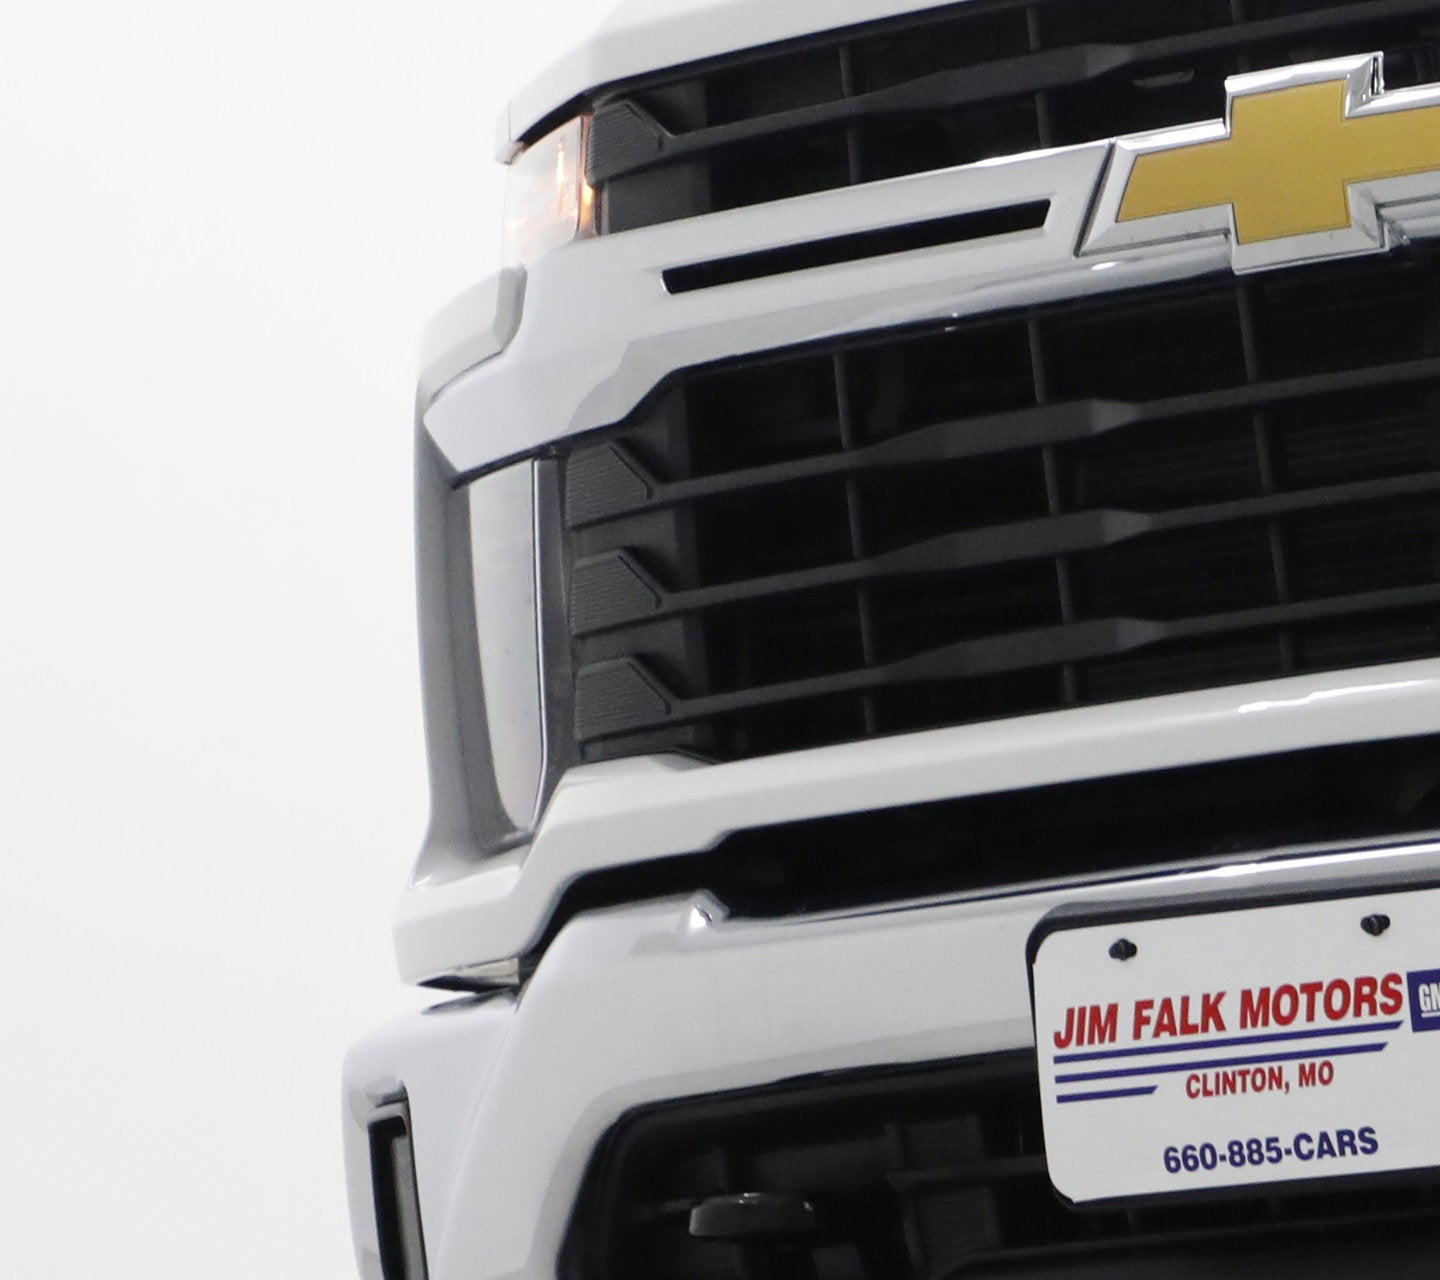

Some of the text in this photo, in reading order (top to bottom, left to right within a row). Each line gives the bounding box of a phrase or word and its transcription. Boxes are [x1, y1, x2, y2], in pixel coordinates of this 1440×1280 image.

[1053, 972, 1404, 1049] JIM FALK MOTORS
[1186, 1060, 1335, 1099] CLINTON, MO
[1162, 1125, 1379, 1174] 660-885-CARS
